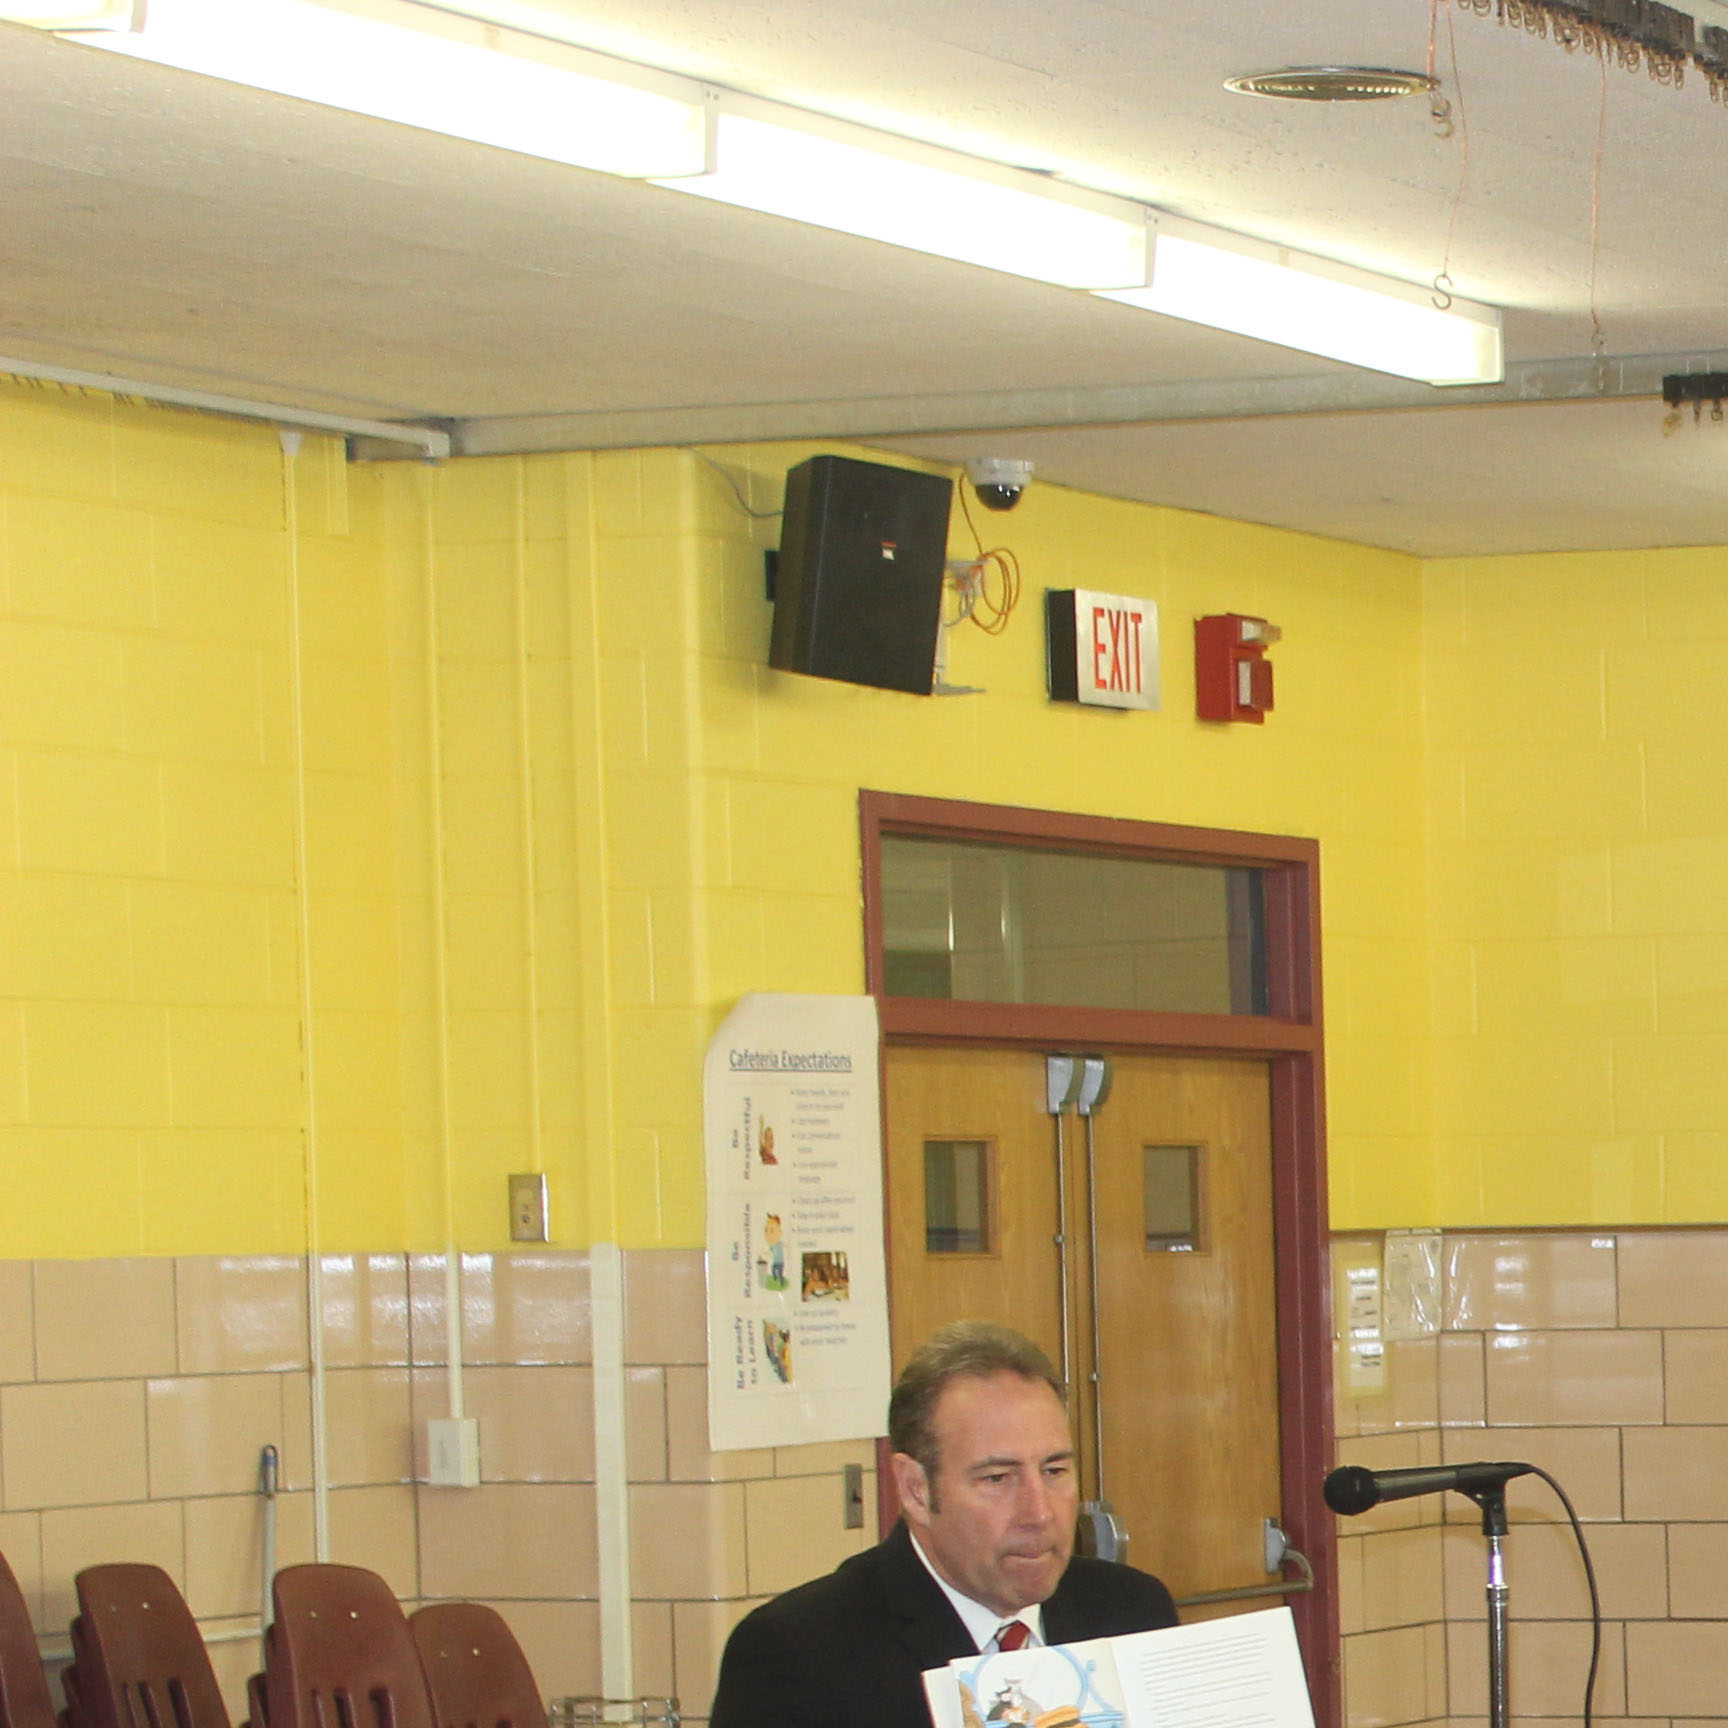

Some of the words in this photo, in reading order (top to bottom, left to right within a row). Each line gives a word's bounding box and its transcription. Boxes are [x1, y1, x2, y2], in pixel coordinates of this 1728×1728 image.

[1093, 607, 1143, 694] EXIT
[729, 1049, 779, 1068] Cafeteria
[781, 1050, 852, 1070] Expectations
